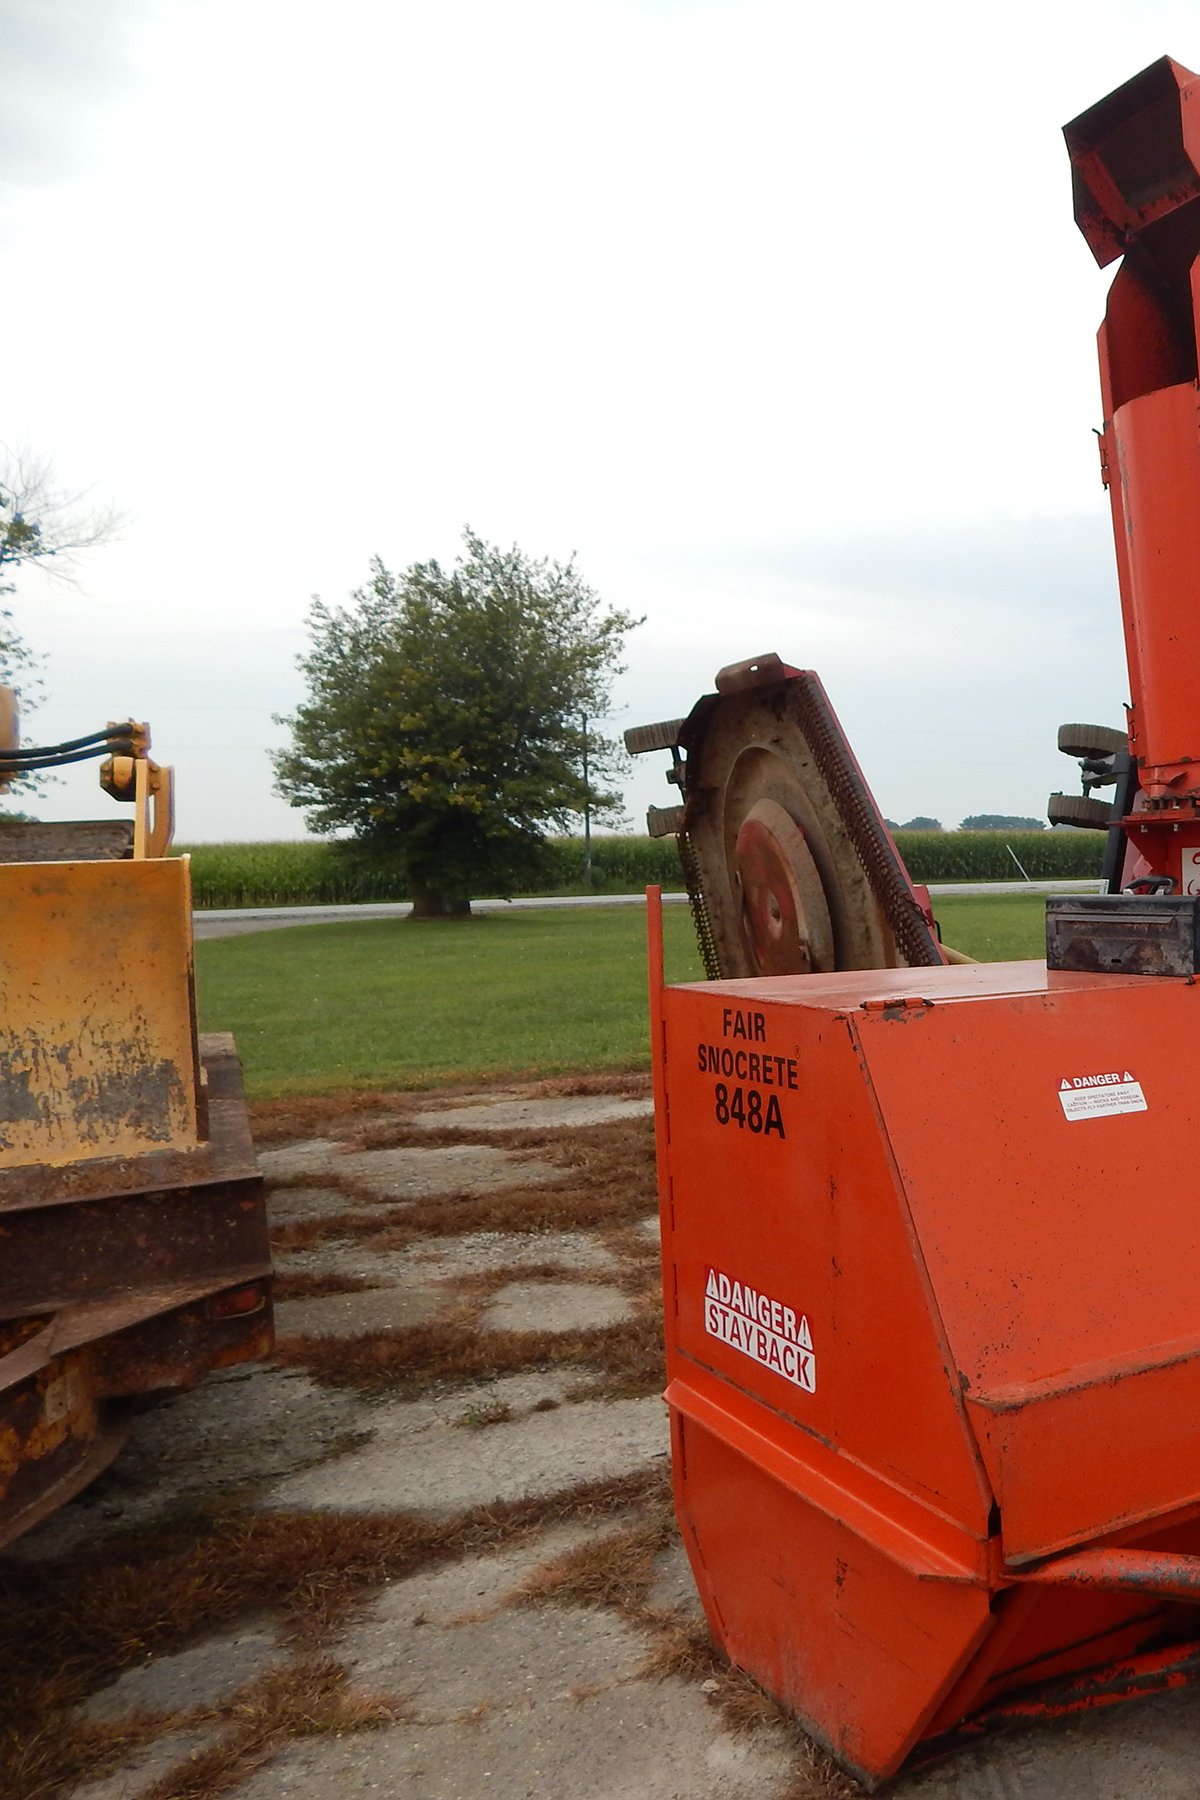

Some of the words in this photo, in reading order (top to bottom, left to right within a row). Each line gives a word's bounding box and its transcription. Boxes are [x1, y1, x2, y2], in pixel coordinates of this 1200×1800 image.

[723, 1008, 766, 1042] FAIR
[1072, 1073, 1121, 1088] DANGER
[715, 1082, 785, 1139] 848A
[719, 1273, 797, 1341] DANGER
[709, 1304, 753, 1352] STAY
[757, 1328, 811, 1387] BACK
